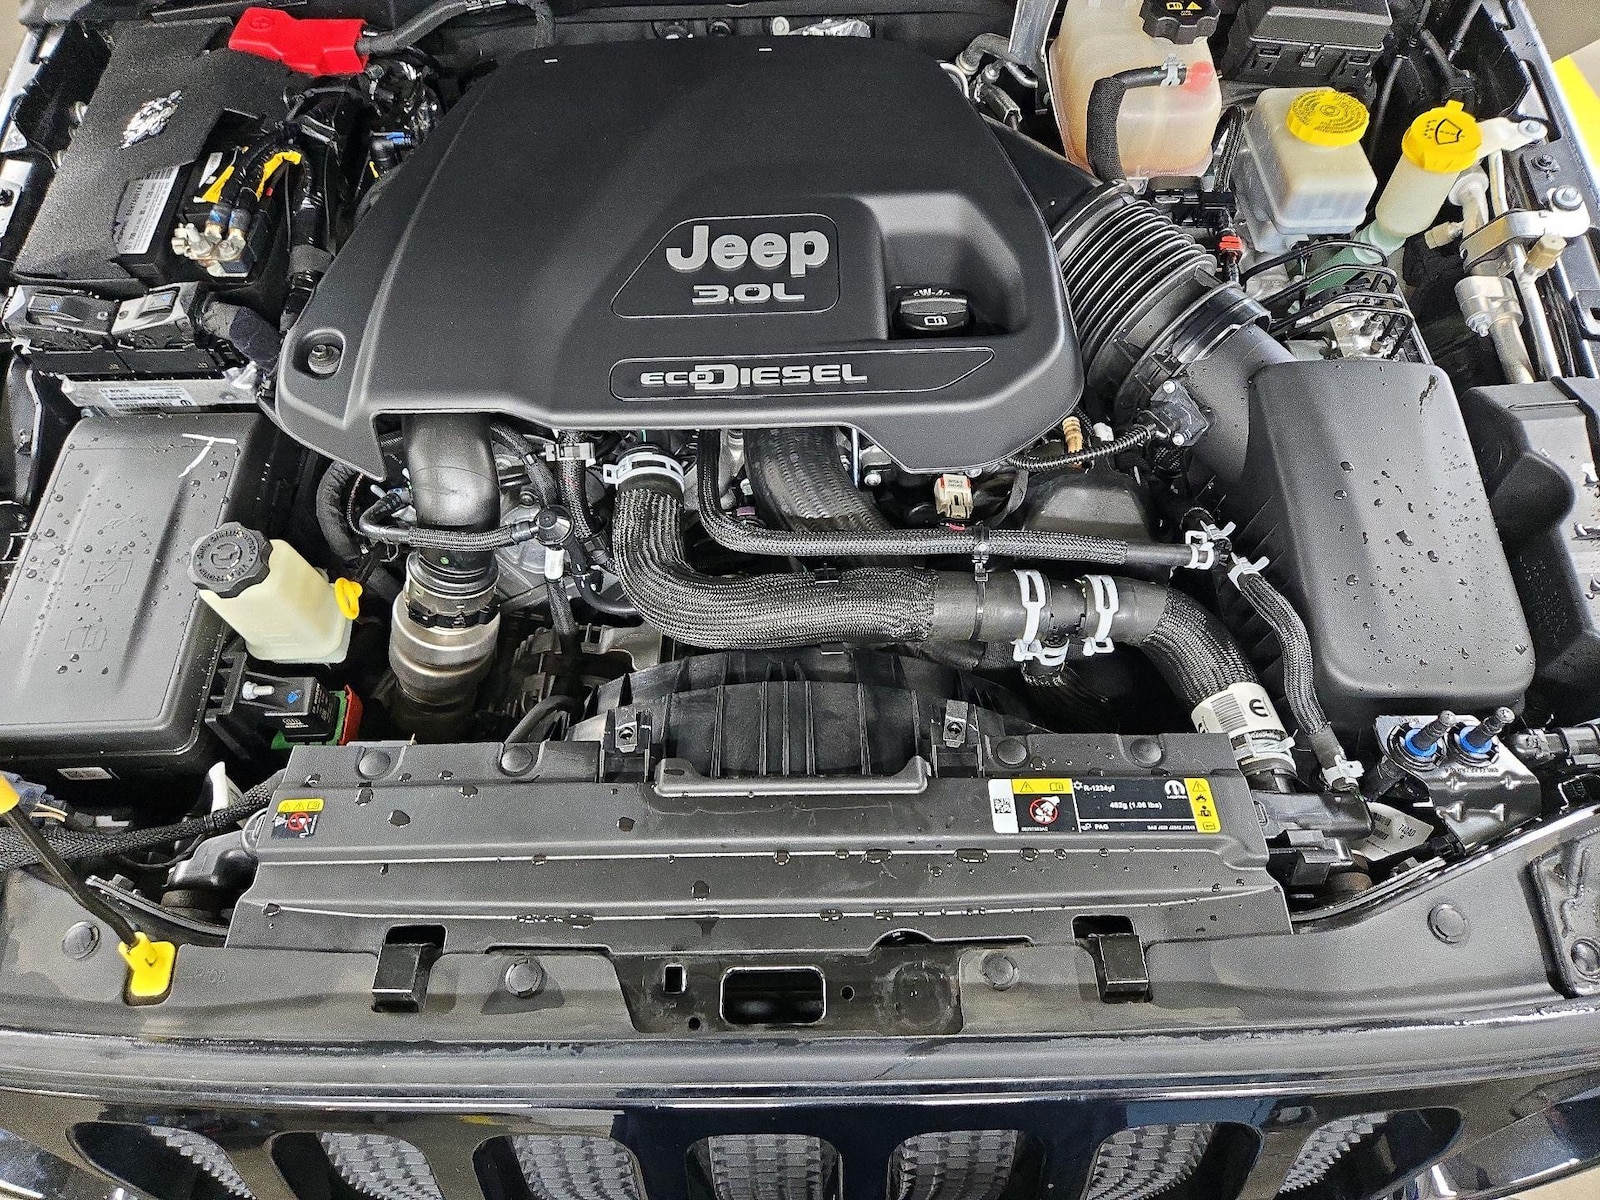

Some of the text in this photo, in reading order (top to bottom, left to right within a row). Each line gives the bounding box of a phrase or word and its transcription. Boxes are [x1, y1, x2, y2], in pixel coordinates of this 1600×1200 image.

[666, 225, 829, 278] Jeep
[692, 282, 805, 305] 3.0L
[1094, 823, 1110, 831] PAG
